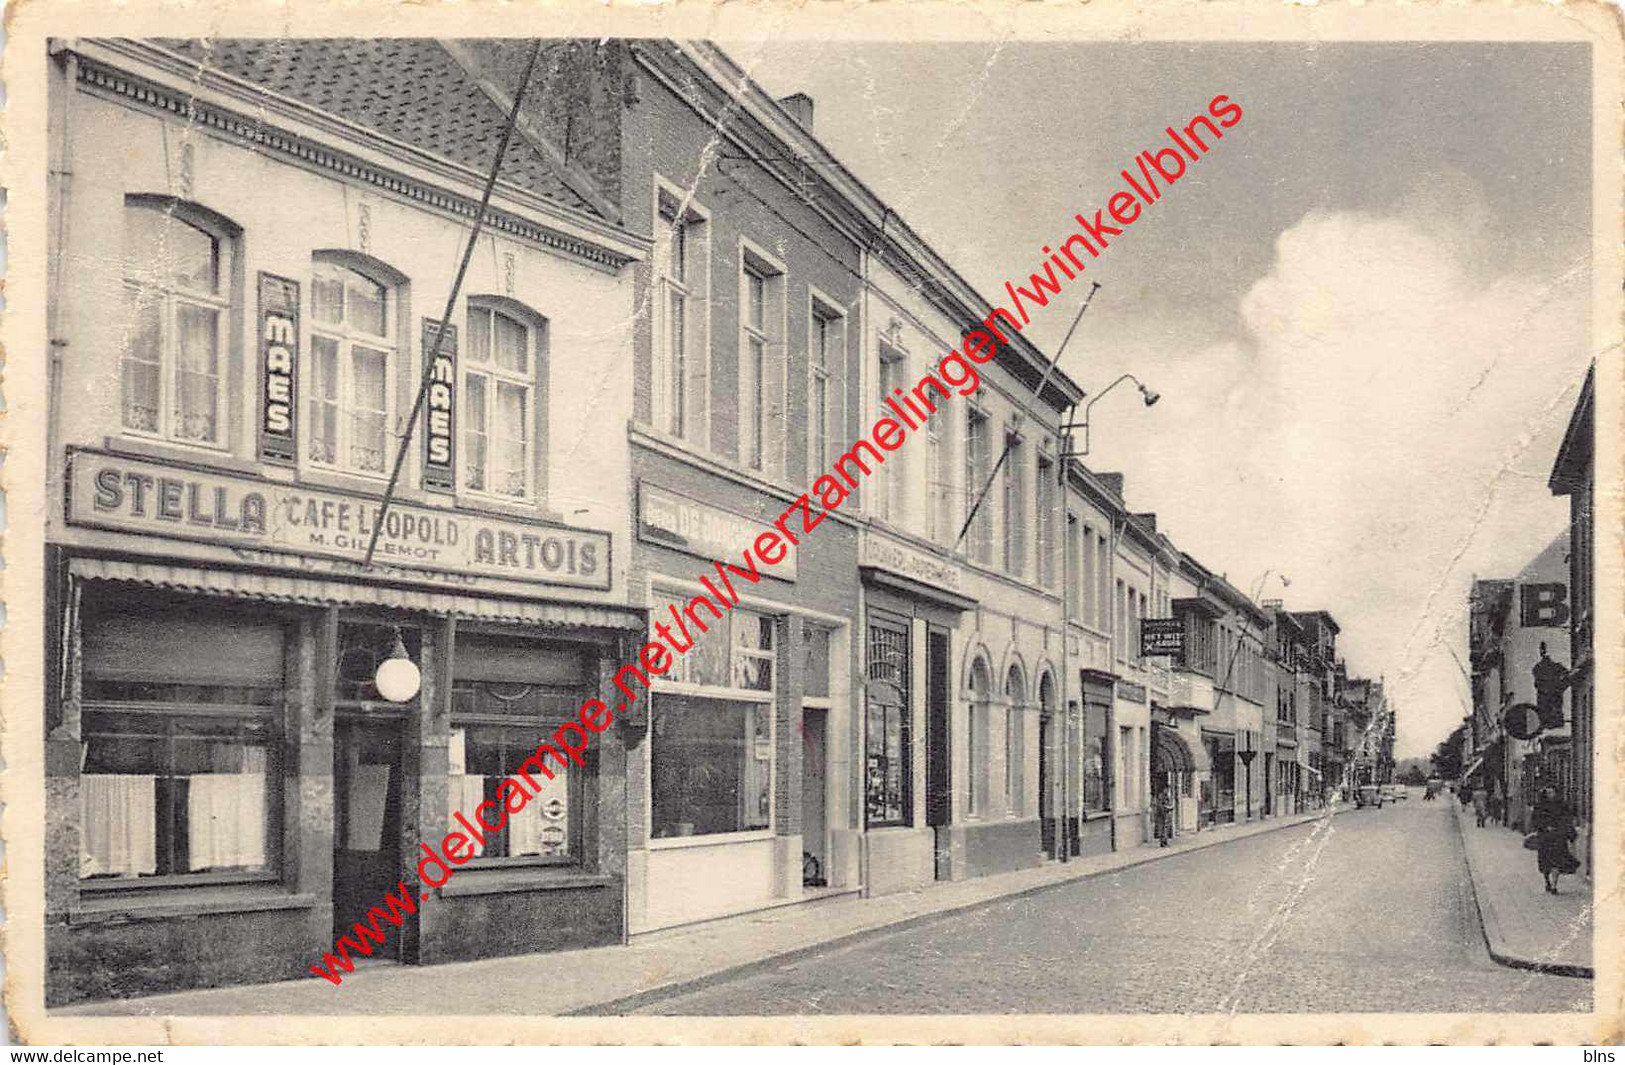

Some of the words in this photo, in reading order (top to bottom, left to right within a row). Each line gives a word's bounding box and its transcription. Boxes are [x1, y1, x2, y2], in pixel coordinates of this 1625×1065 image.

[265, 315, 294, 431] MAES
[428, 357, 454, 462] MAES
[93, 467, 267, 534] STELLA
[357, 503, 459, 547] LEOPOLD
[309, 533, 331, 546] M.
[473, 527, 597, 574] ARTOIS
